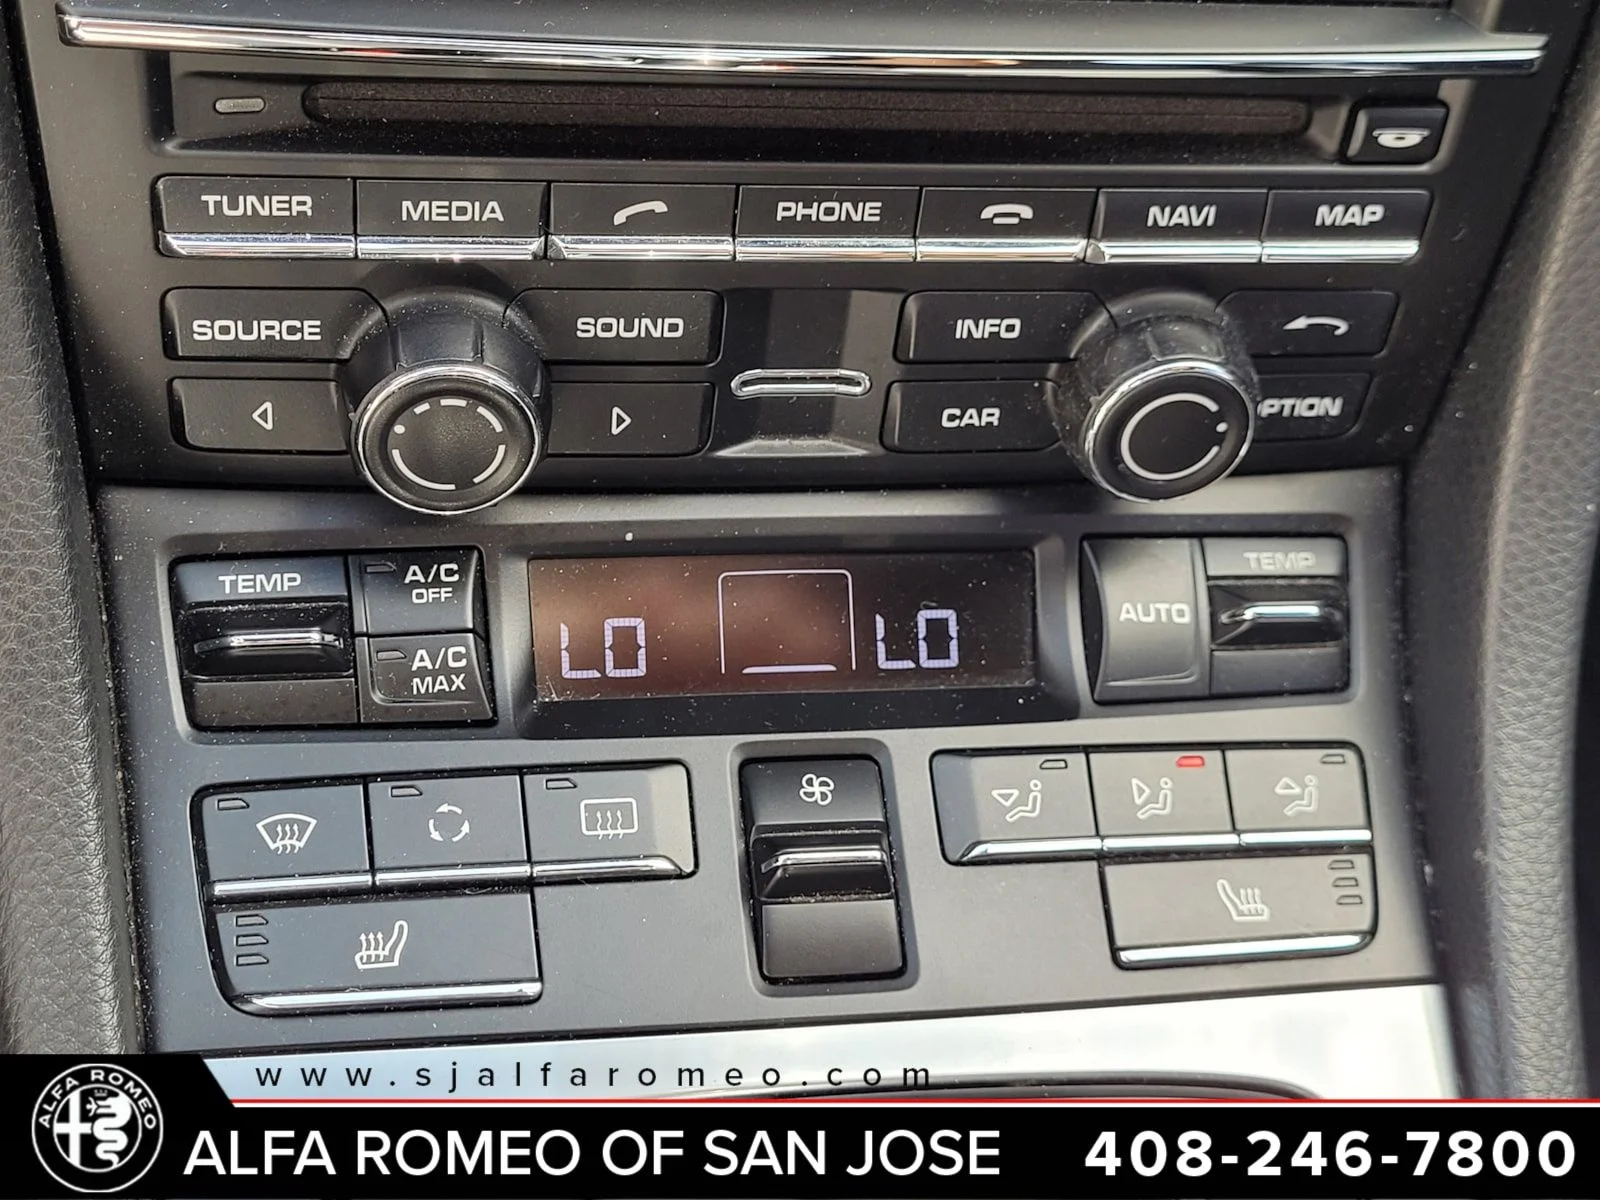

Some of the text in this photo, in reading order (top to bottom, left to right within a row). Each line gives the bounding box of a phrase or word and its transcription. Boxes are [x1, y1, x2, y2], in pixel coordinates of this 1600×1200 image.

[201, 194, 313, 218] TUNER
[401, 200, 504, 222] MEDIA
[776, 200, 882, 223] PHONE
[1147, 205, 1217, 228] NAVI
[1315, 204, 1385, 227] MAP
[192, 319, 322, 341] SOURCE
[576, 316, 684, 339] SOUND
[955, 318, 1022, 340] INFO
[941, 407, 1000, 428] CAR
[1243, 551, 1316, 570] TEMP
[218, 572, 302, 595] TEMP
[404, 563, 460, 584] A/C
[411, 587, 453, 604] OFF
[1119, 602, 1191, 625] AUTO
[411, 646, 468, 670] A/C
[412, 674, 467, 695] MAX
